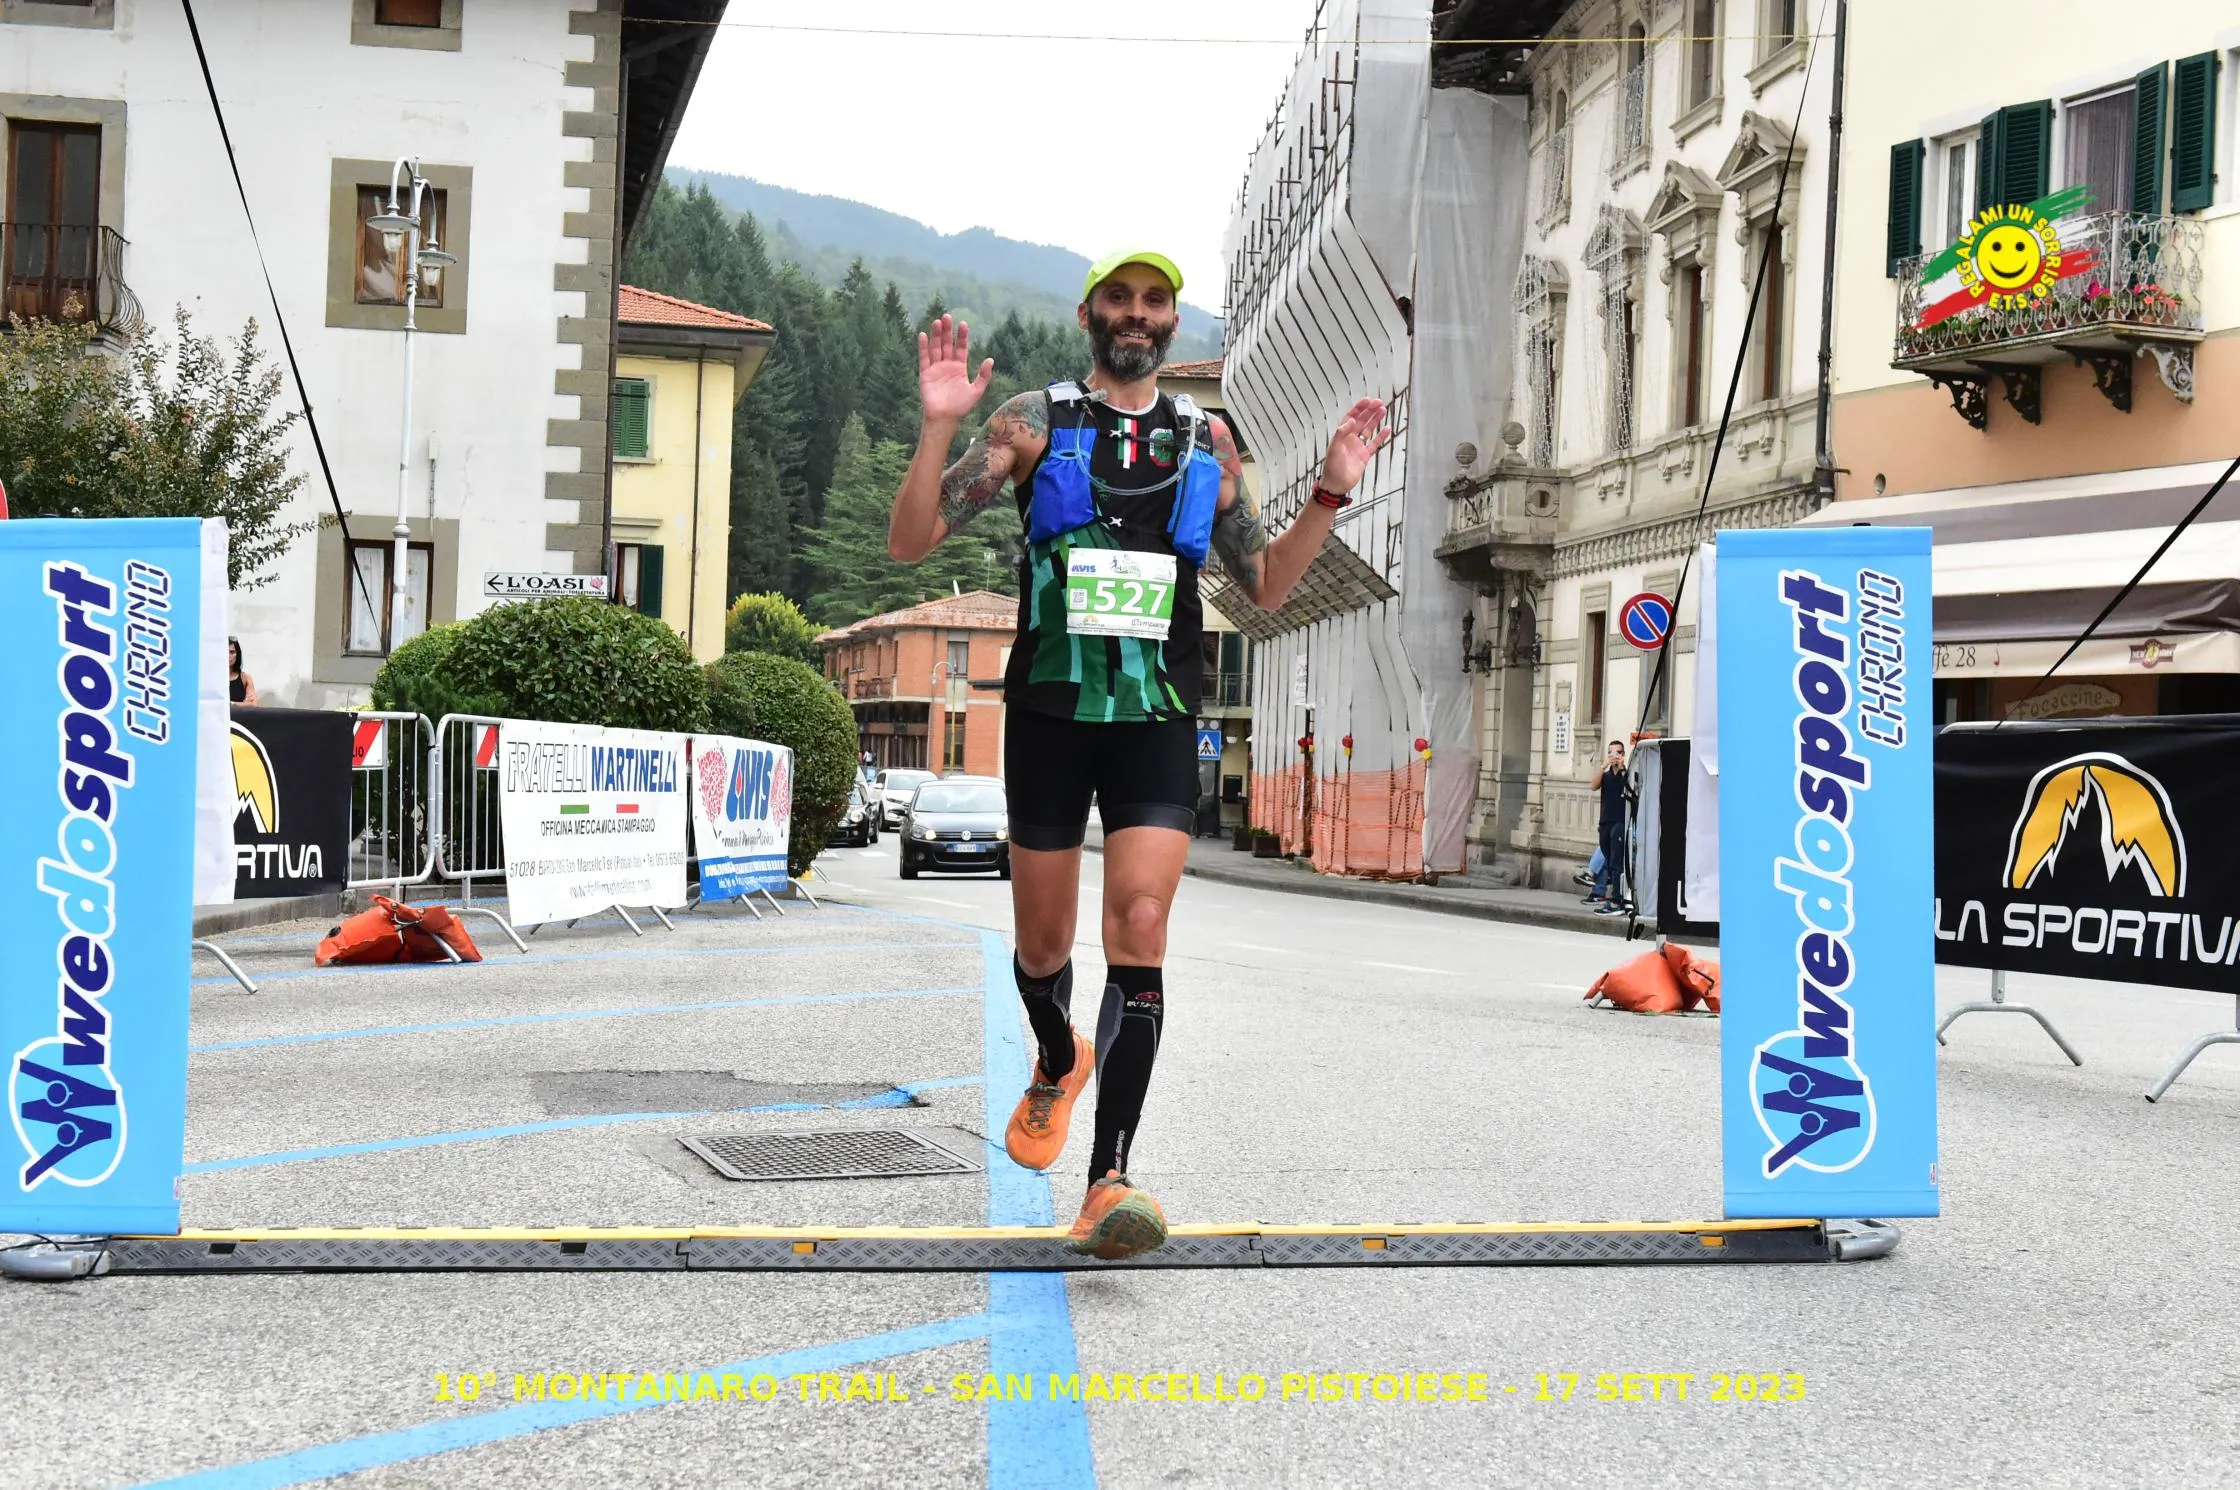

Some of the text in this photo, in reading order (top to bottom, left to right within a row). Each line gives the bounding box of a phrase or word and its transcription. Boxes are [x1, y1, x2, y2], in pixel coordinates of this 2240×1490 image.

[506, 576, 584, 590] L'OASI
[1071, 564, 1097, 573] AVIS
[1093, 580, 1168, 615] 527
[125, 561, 171, 742] CHRONO
[1858, 569, 1904, 747] CHRONO
[1955, 645, 1976, 668] 28
[2018, 686, 2103, 718] Focaccine
[507, 741, 677, 794] FRATELLI MARTINELLI
[725, 748, 774, 823] AVIS
[41, 561, 131, 1066] wedosport
[540, 820, 573, 837] OFFICINA
[617, 818, 656, 833] STAMPAGGIO
[1778, 572, 1867, 1060] wedosport
[234, 844, 323, 879] RTIVA
[1934, 897, 1989, 944] LA
